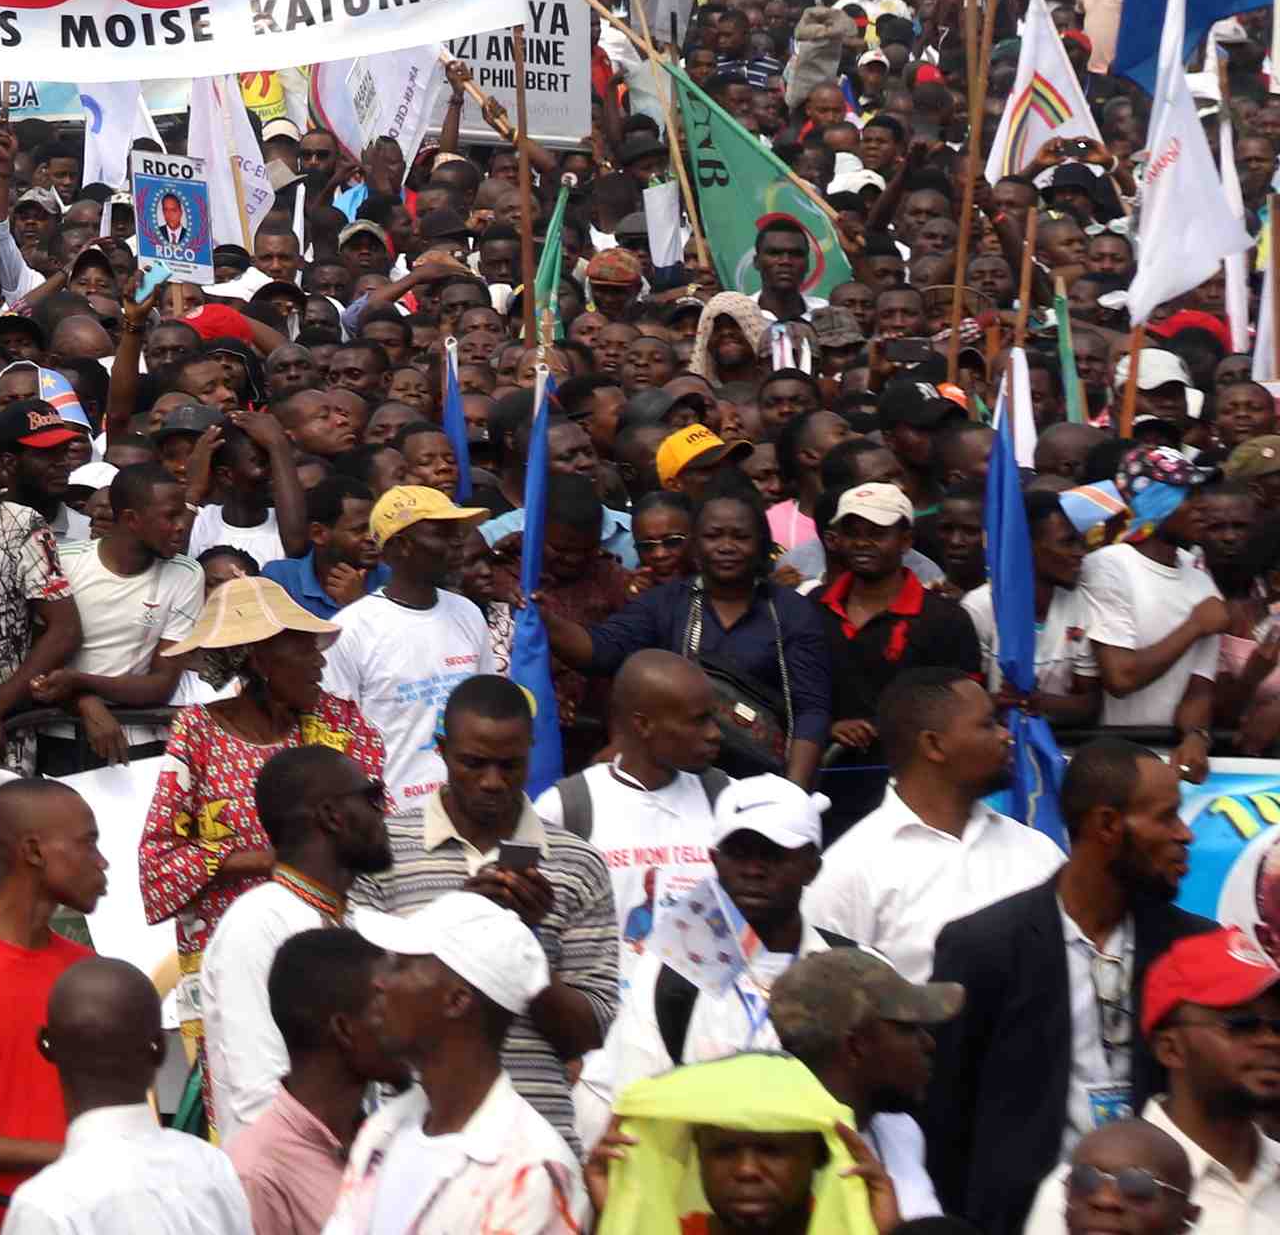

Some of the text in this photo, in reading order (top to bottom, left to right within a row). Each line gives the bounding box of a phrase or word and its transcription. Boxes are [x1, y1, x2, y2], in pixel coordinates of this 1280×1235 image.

[61, 6, 213, 49] MOISE
[480, 70, 572, 94] PHILBERT
[143, 159, 194, 180] RDCO
[155, 245, 196, 262] RDCO
